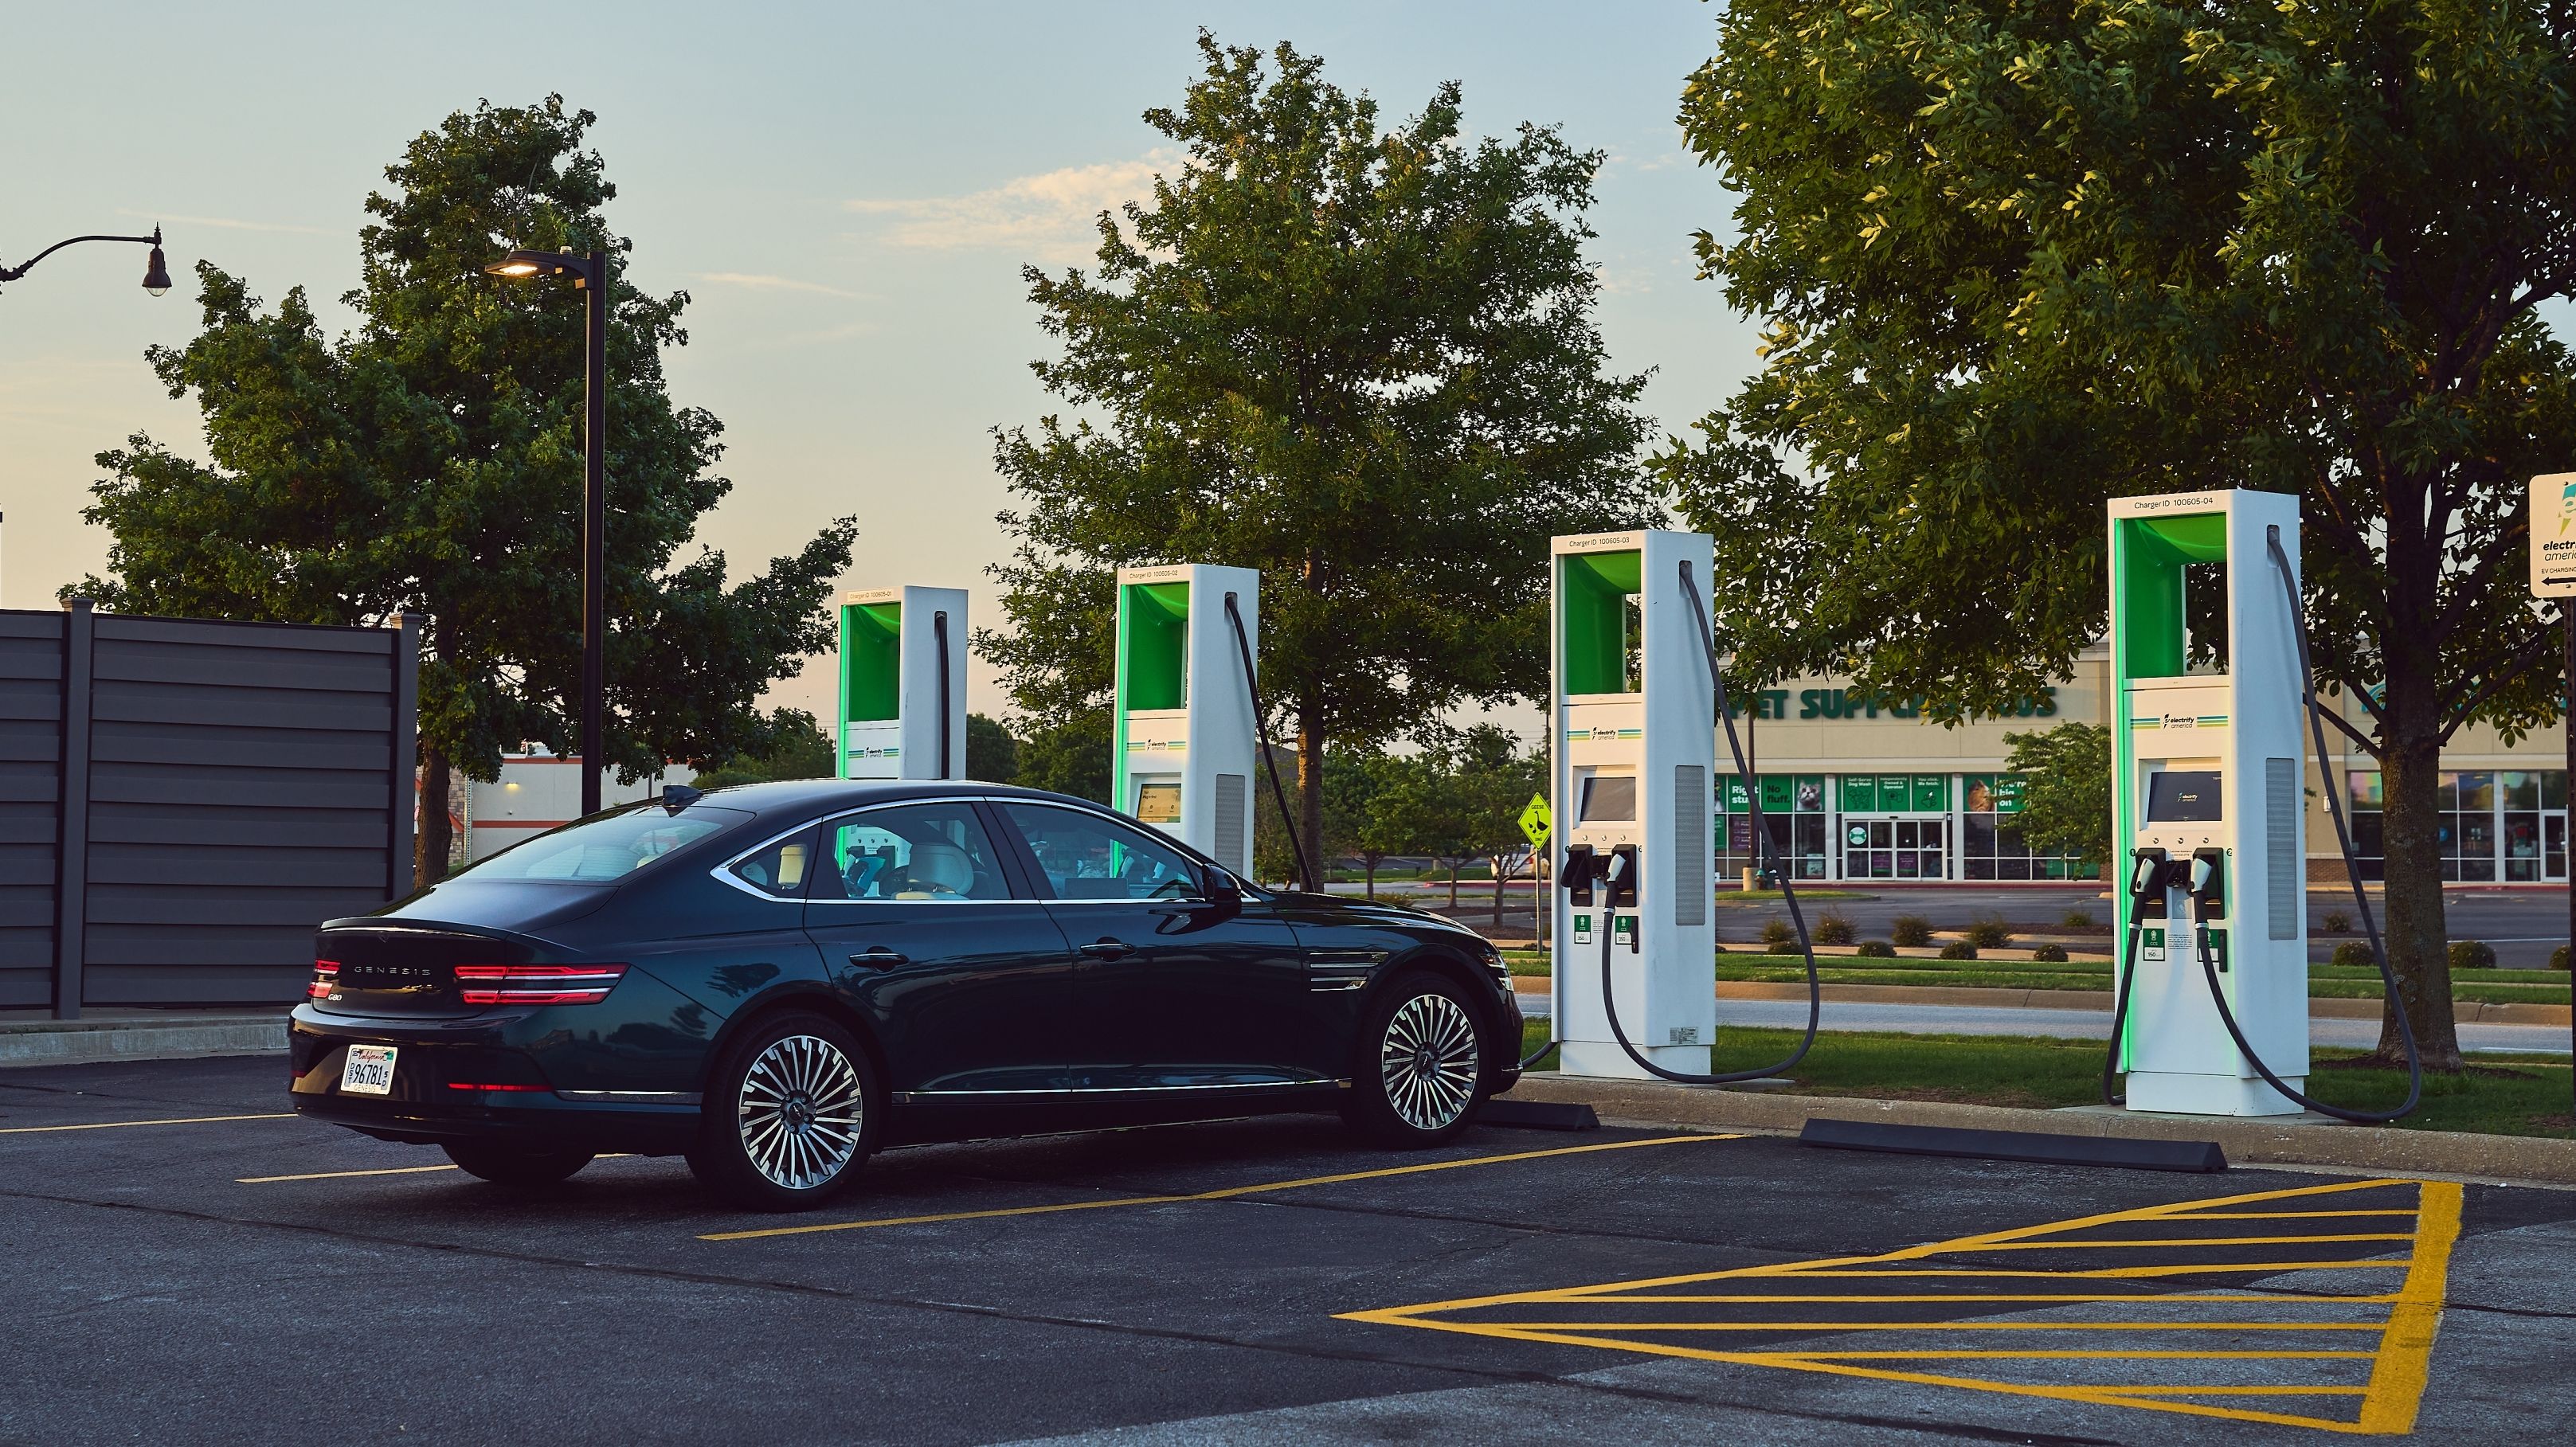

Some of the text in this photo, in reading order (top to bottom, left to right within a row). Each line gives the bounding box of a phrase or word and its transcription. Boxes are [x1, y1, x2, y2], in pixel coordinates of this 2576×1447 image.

[2174, 497, 2214, 506] 100605-04
[2543, 541, 2576, 550] electr
[1732, 785, 1759, 796] Rigt
[1767, 795, 1791, 804] fluff.
[354, 966, 431, 976] GENESIS
[358, 1050, 387, 1063] California
[353, 1062, 383, 1085] 96781
[354, 1084, 377, 1093] GENESIS
